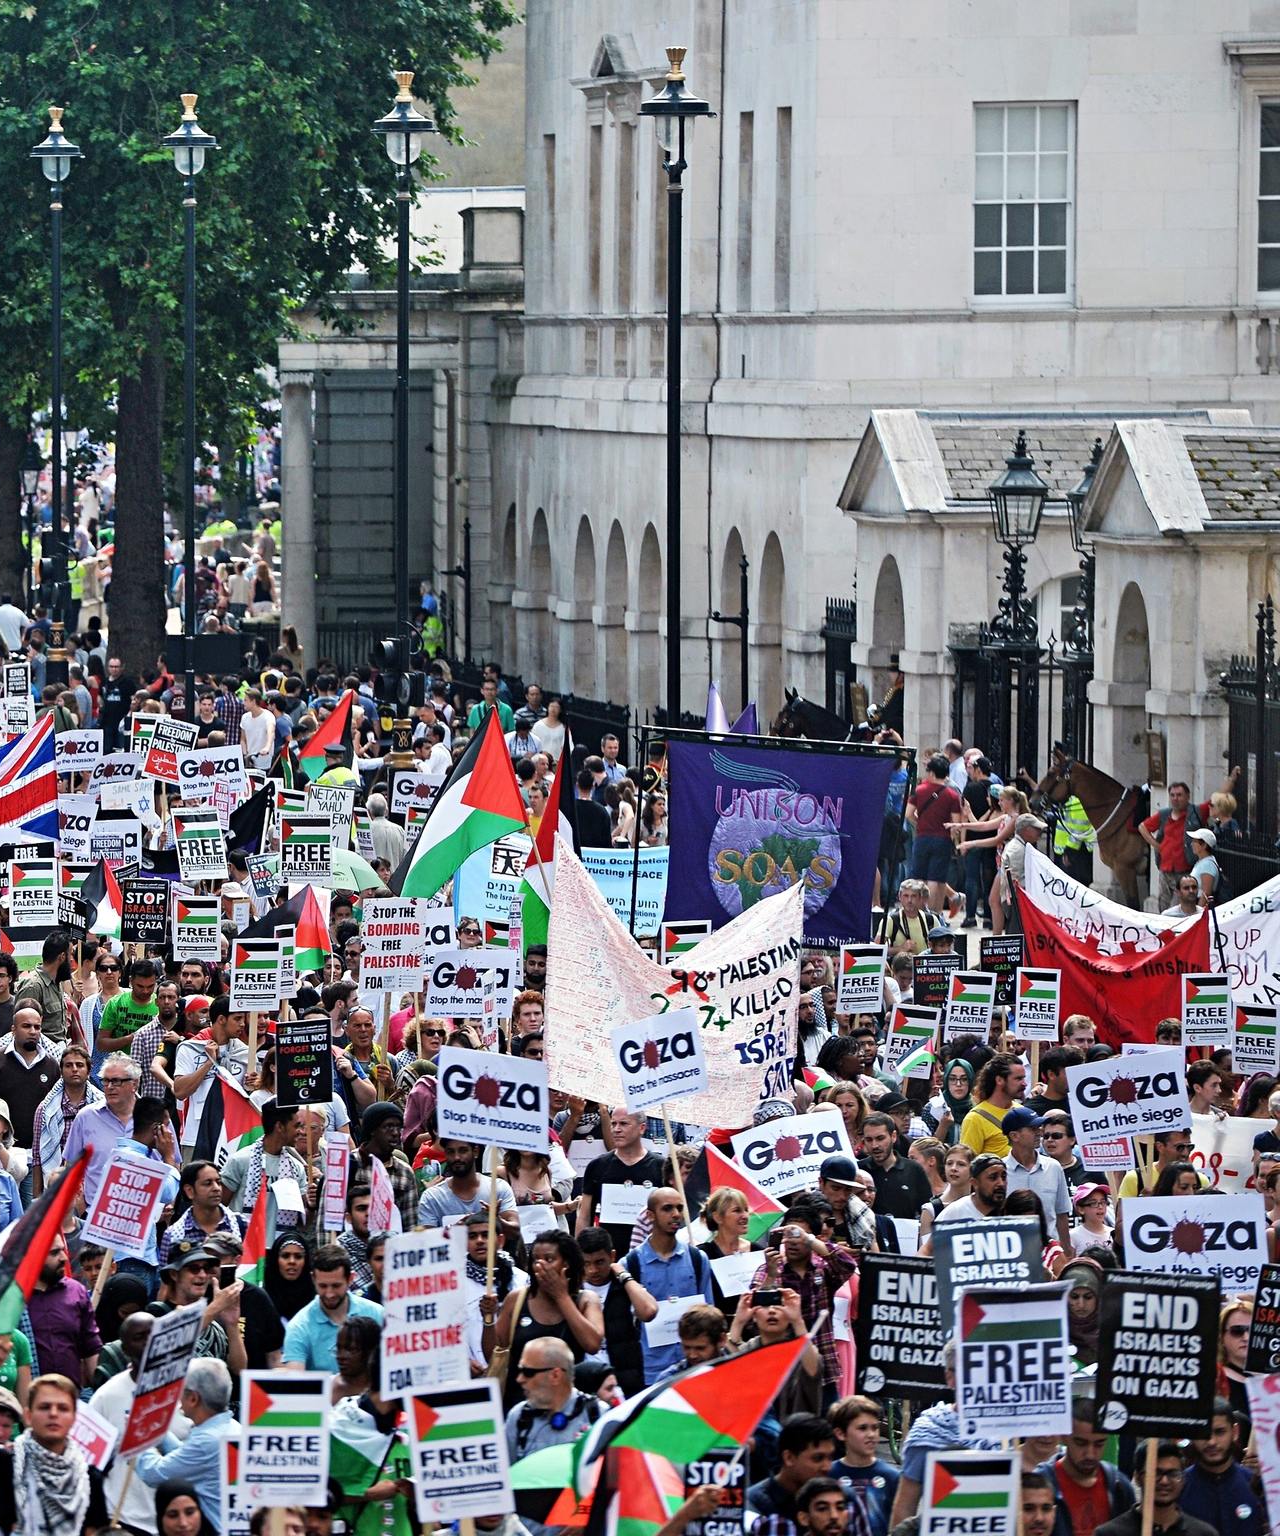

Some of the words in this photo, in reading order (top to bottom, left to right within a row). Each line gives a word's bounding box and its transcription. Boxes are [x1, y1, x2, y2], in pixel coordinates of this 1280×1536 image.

[158, 725, 192, 740] FREEDOM
[180, 757, 240, 778] Gza
[311, 788, 349, 801] NETAN-
[318, 801, 342, 812] YAHU
[715, 786, 844, 829] UNISON
[178, 840, 223, 858] FREE
[282, 844, 331, 862] FREE
[180, 854, 226, 867] PALESTINE
[281, 860, 330, 872] PALESTINE
[714, 847, 837, 889] SOAS
[628, 870, 663, 879] PEACE
[13, 889, 53, 899] FREE
[1040, 873, 1076, 900] YOU
[13, 898, 53, 907] PALESTINE
[126, 892, 165, 904] STOP
[125, 904, 163, 914] ISRAEL'S
[373, 907, 396, 919] STOP
[398, 907, 416, 918] THE
[137, 921, 163, 930] GAZA
[177, 926, 217, 936] FREE
[367, 922, 420, 938] BOMBING
[177, 935, 217, 943] PALESTINE
[381, 939, 401, 952] FREE
[1234, 929, 1261, 950] UP
[364, 954, 421, 969] PALESTINE
[234, 973, 277, 983] FREE
[234, 981, 276, 991] PALESTINE
[842, 976, 879, 988] FREE
[841, 985, 879, 995] PALESTINE
[951, 1005, 988, 1016] FREE
[1019, 1001, 1055, 1013] FREE
[1019, 1011, 1055, 1020] PALESTINE
[1186, 1007, 1227, 1017] FREE
[949, 1015, 987, 1024] PALESTINE
[1186, 1017, 1227, 1026] PALESTINE
[280, 1036, 289, 1044] WE
[291, 1035, 308, 1044] WILL
[311, 1034, 327, 1044] NOT
[1235, 1036, 1274, 1047] FREE
[280, 1044, 308, 1054] FORGET
[310, 1043, 327, 1052] YOU
[619, 1030, 696, 1074] Gza
[1235, 1045, 1275, 1055] PALESTINE
[294, 1054, 317, 1063] GAZA
[442, 1064, 542, 1113] Gza
[1076, 1072, 1179, 1108] Gza
[443, 1109, 465, 1124] Stop
[468, 1112, 486, 1126] the
[489, 1117, 542, 1134] massacre
[1082, 1118, 1107, 1134] End
[1115, 1113, 1138, 1129] the
[1142, 1107, 1184, 1126] siege
[743, 1129, 843, 1171] Gza
[1084, 1141, 1128, 1158] TERROR
[118, 1169, 151, 1187] STOP
[107, 1181, 153, 1205] ISRAELI
[106, 1202, 142, 1221] STATE
[96, 1212, 142, 1238] TERROR
[1130, 1214, 1258, 1254] Gza
[952, 1232, 1022, 1263] END
[393, 1249, 423, 1269] STOP
[426, 1244, 450, 1264] THE
[950, 1262, 1029, 1280] ISRAEL'S
[388, 1272, 458, 1300] BOMBING
[406, 1304, 437, 1321] FREE
[1122, 1293, 1199, 1331] END
[386, 1324, 462, 1357] PALESTINE
[1115, 1333, 1201, 1355] ISRAEL'S
[962, 1340, 1063, 1384] FREE
[1113, 1355, 1200, 1378] ATTACKS
[389, 1368, 413, 1389] FOA
[963, 1382, 1065, 1405] PALESTINE
[1112, 1376, 1139, 1396] ON
[1144, 1377, 1198, 1400] GAZA
[248, 1435, 320, 1452] FREE
[246, 1454, 319, 1467] PALESTINE
[421, 1444, 497, 1467] FREE
[421, 1462, 500, 1481] PALESTINE
[688, 1461, 743, 1486] STOP
[703, 1520, 743, 1536] GAZA
[930, 1516, 1006, 1534] FREE
